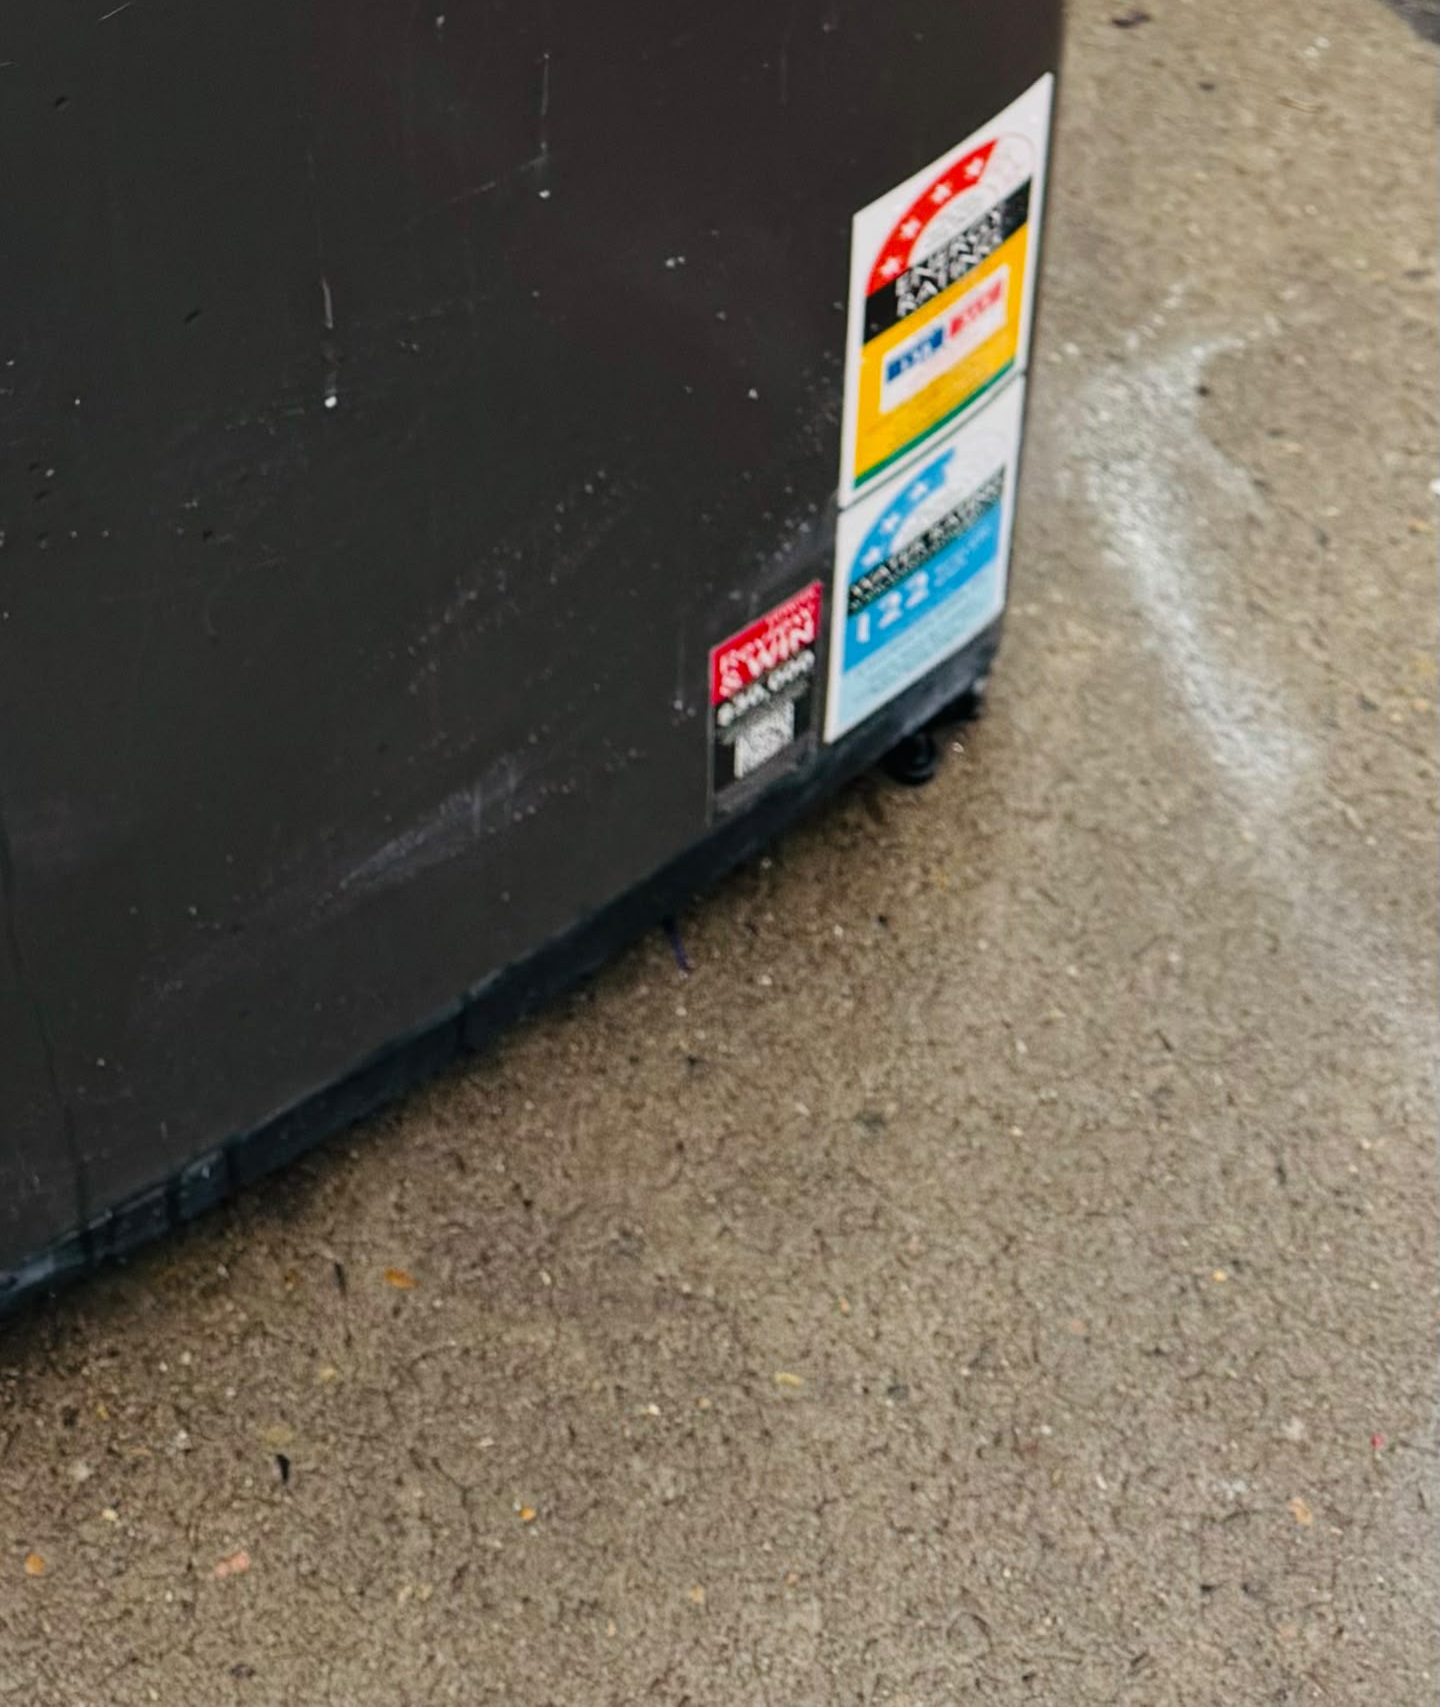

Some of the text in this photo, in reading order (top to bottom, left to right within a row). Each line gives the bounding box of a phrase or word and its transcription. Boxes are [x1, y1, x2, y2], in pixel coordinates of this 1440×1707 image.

[895, 205, 1002, 297] ENERGY
[896, 231, 1004, 318] RATING
[746, 617, 814, 678] WIN
